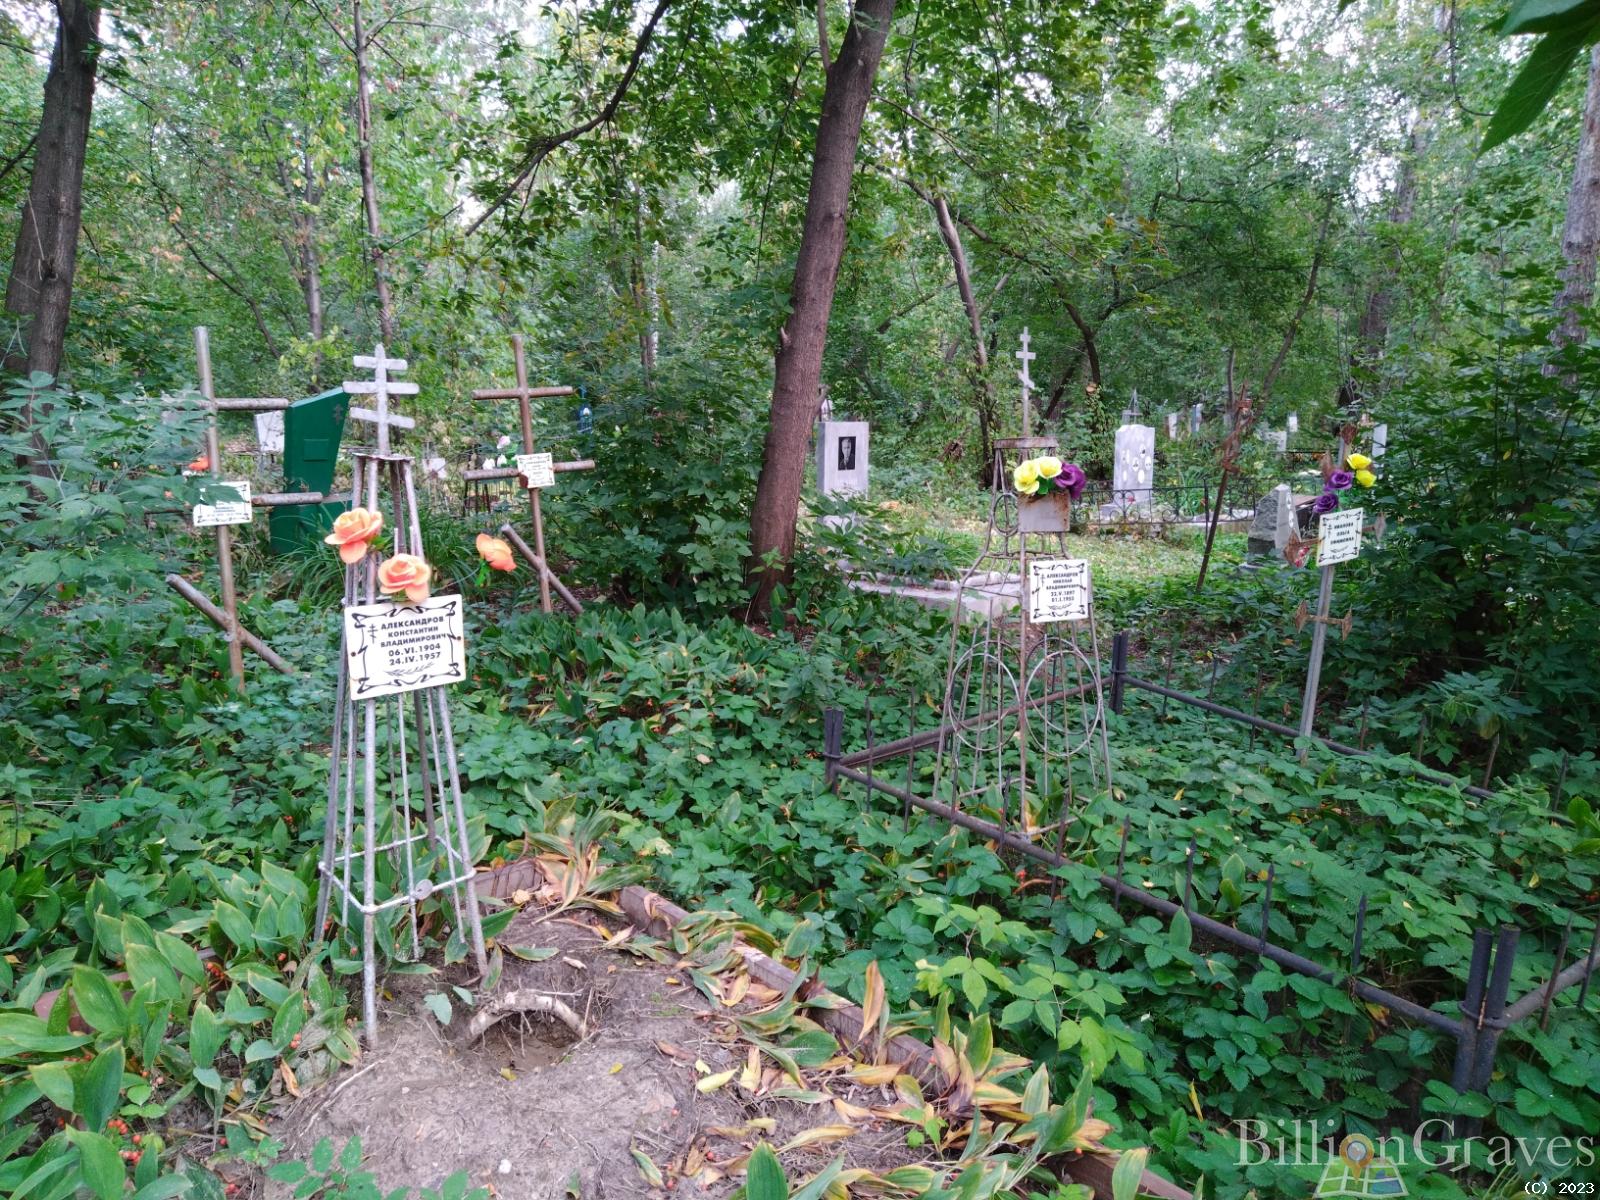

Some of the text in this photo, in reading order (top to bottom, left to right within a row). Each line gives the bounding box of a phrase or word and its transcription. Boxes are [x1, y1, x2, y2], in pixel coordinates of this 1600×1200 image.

[381, 616, 444, 630] АЛЕКСАНДРОВ
[388, 626, 439, 638] КОНСТАНТИН
[380, 633, 447, 648] ВЛАДИМИРОВИЧ
[388, 643, 441, 657] 06.VI.1904
[389, 652, 441, 666] 24.IV.1957
